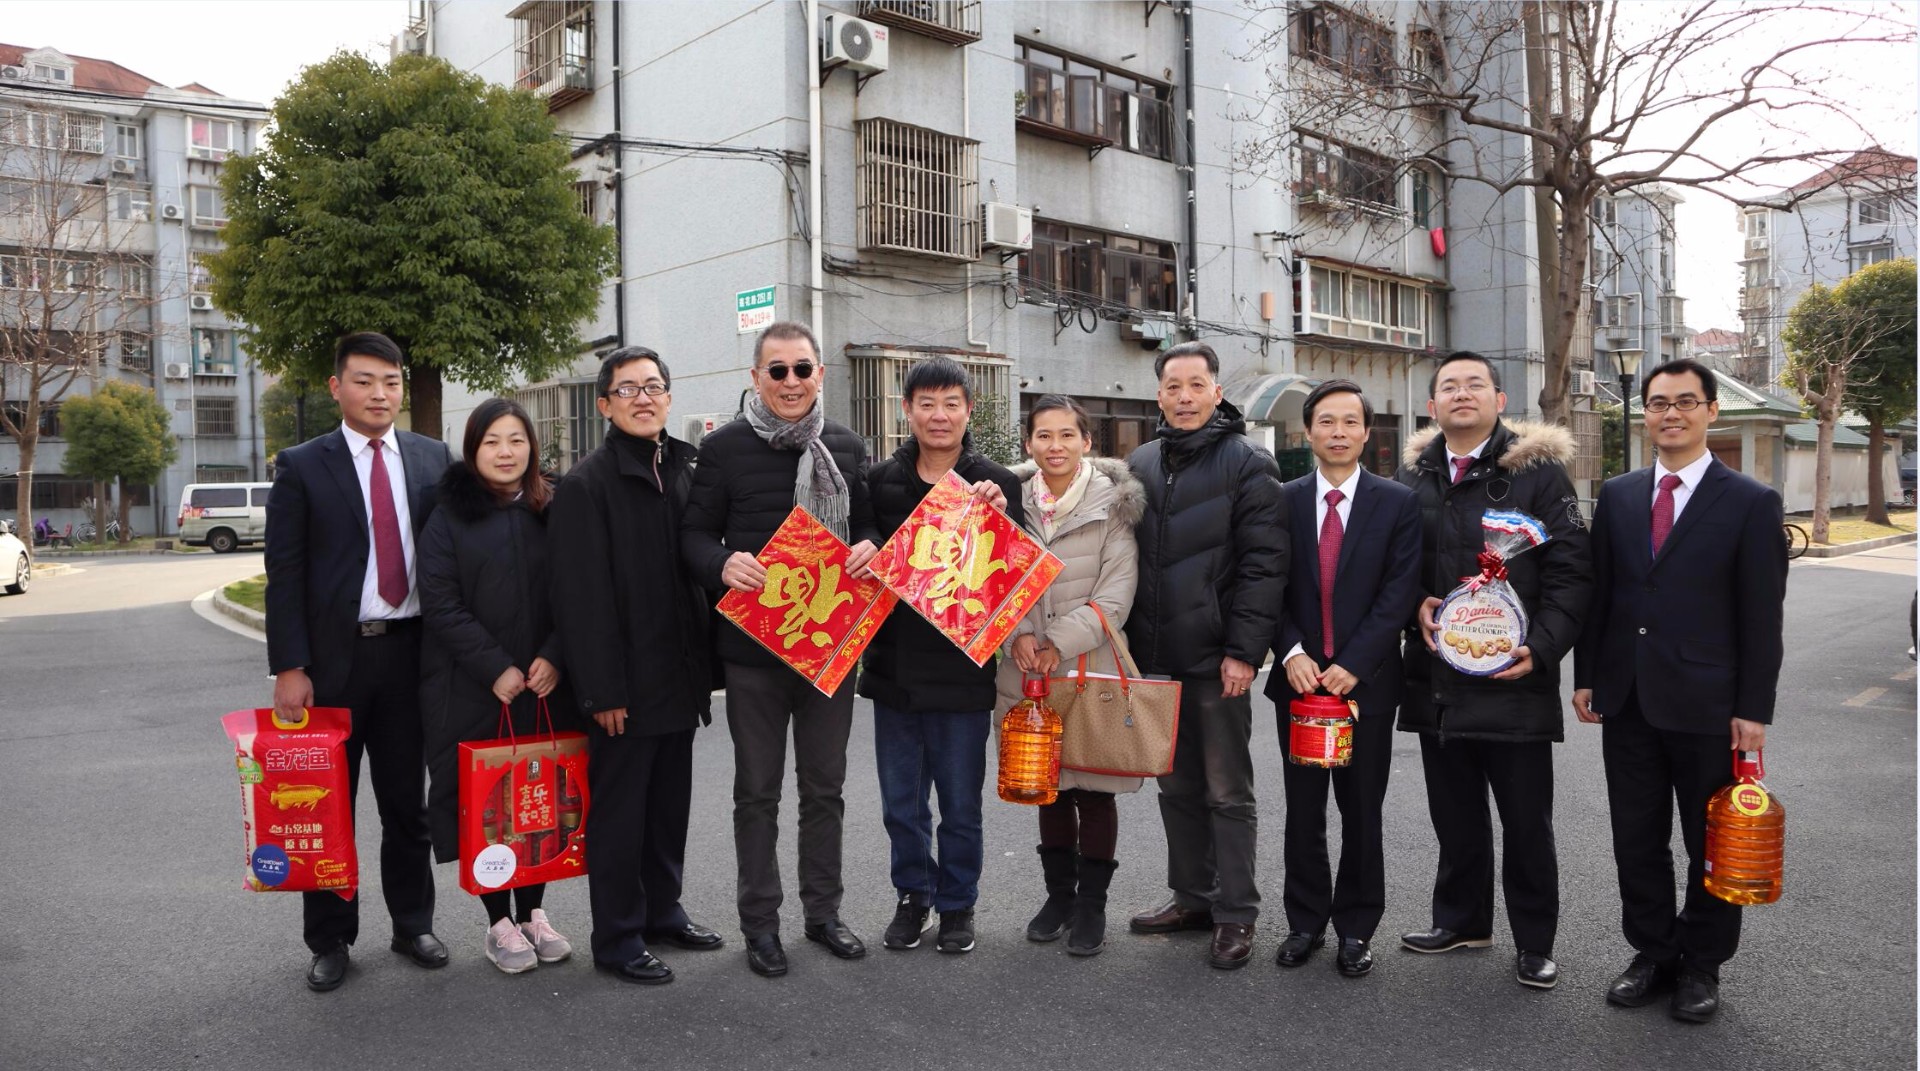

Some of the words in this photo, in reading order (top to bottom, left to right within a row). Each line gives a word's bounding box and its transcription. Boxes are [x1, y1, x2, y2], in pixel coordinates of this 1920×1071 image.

[908, 524, 1009, 616] 福
[758, 558, 853, 650] 福
[1451, 604, 1503, 624] Danisa
[1451, 624, 1477, 633] BUTTER
[1478, 626, 1508, 636] COOKIES
[266, 747, 330, 771] 金龙鱼
[284, 823, 322, 834] 五常基地
